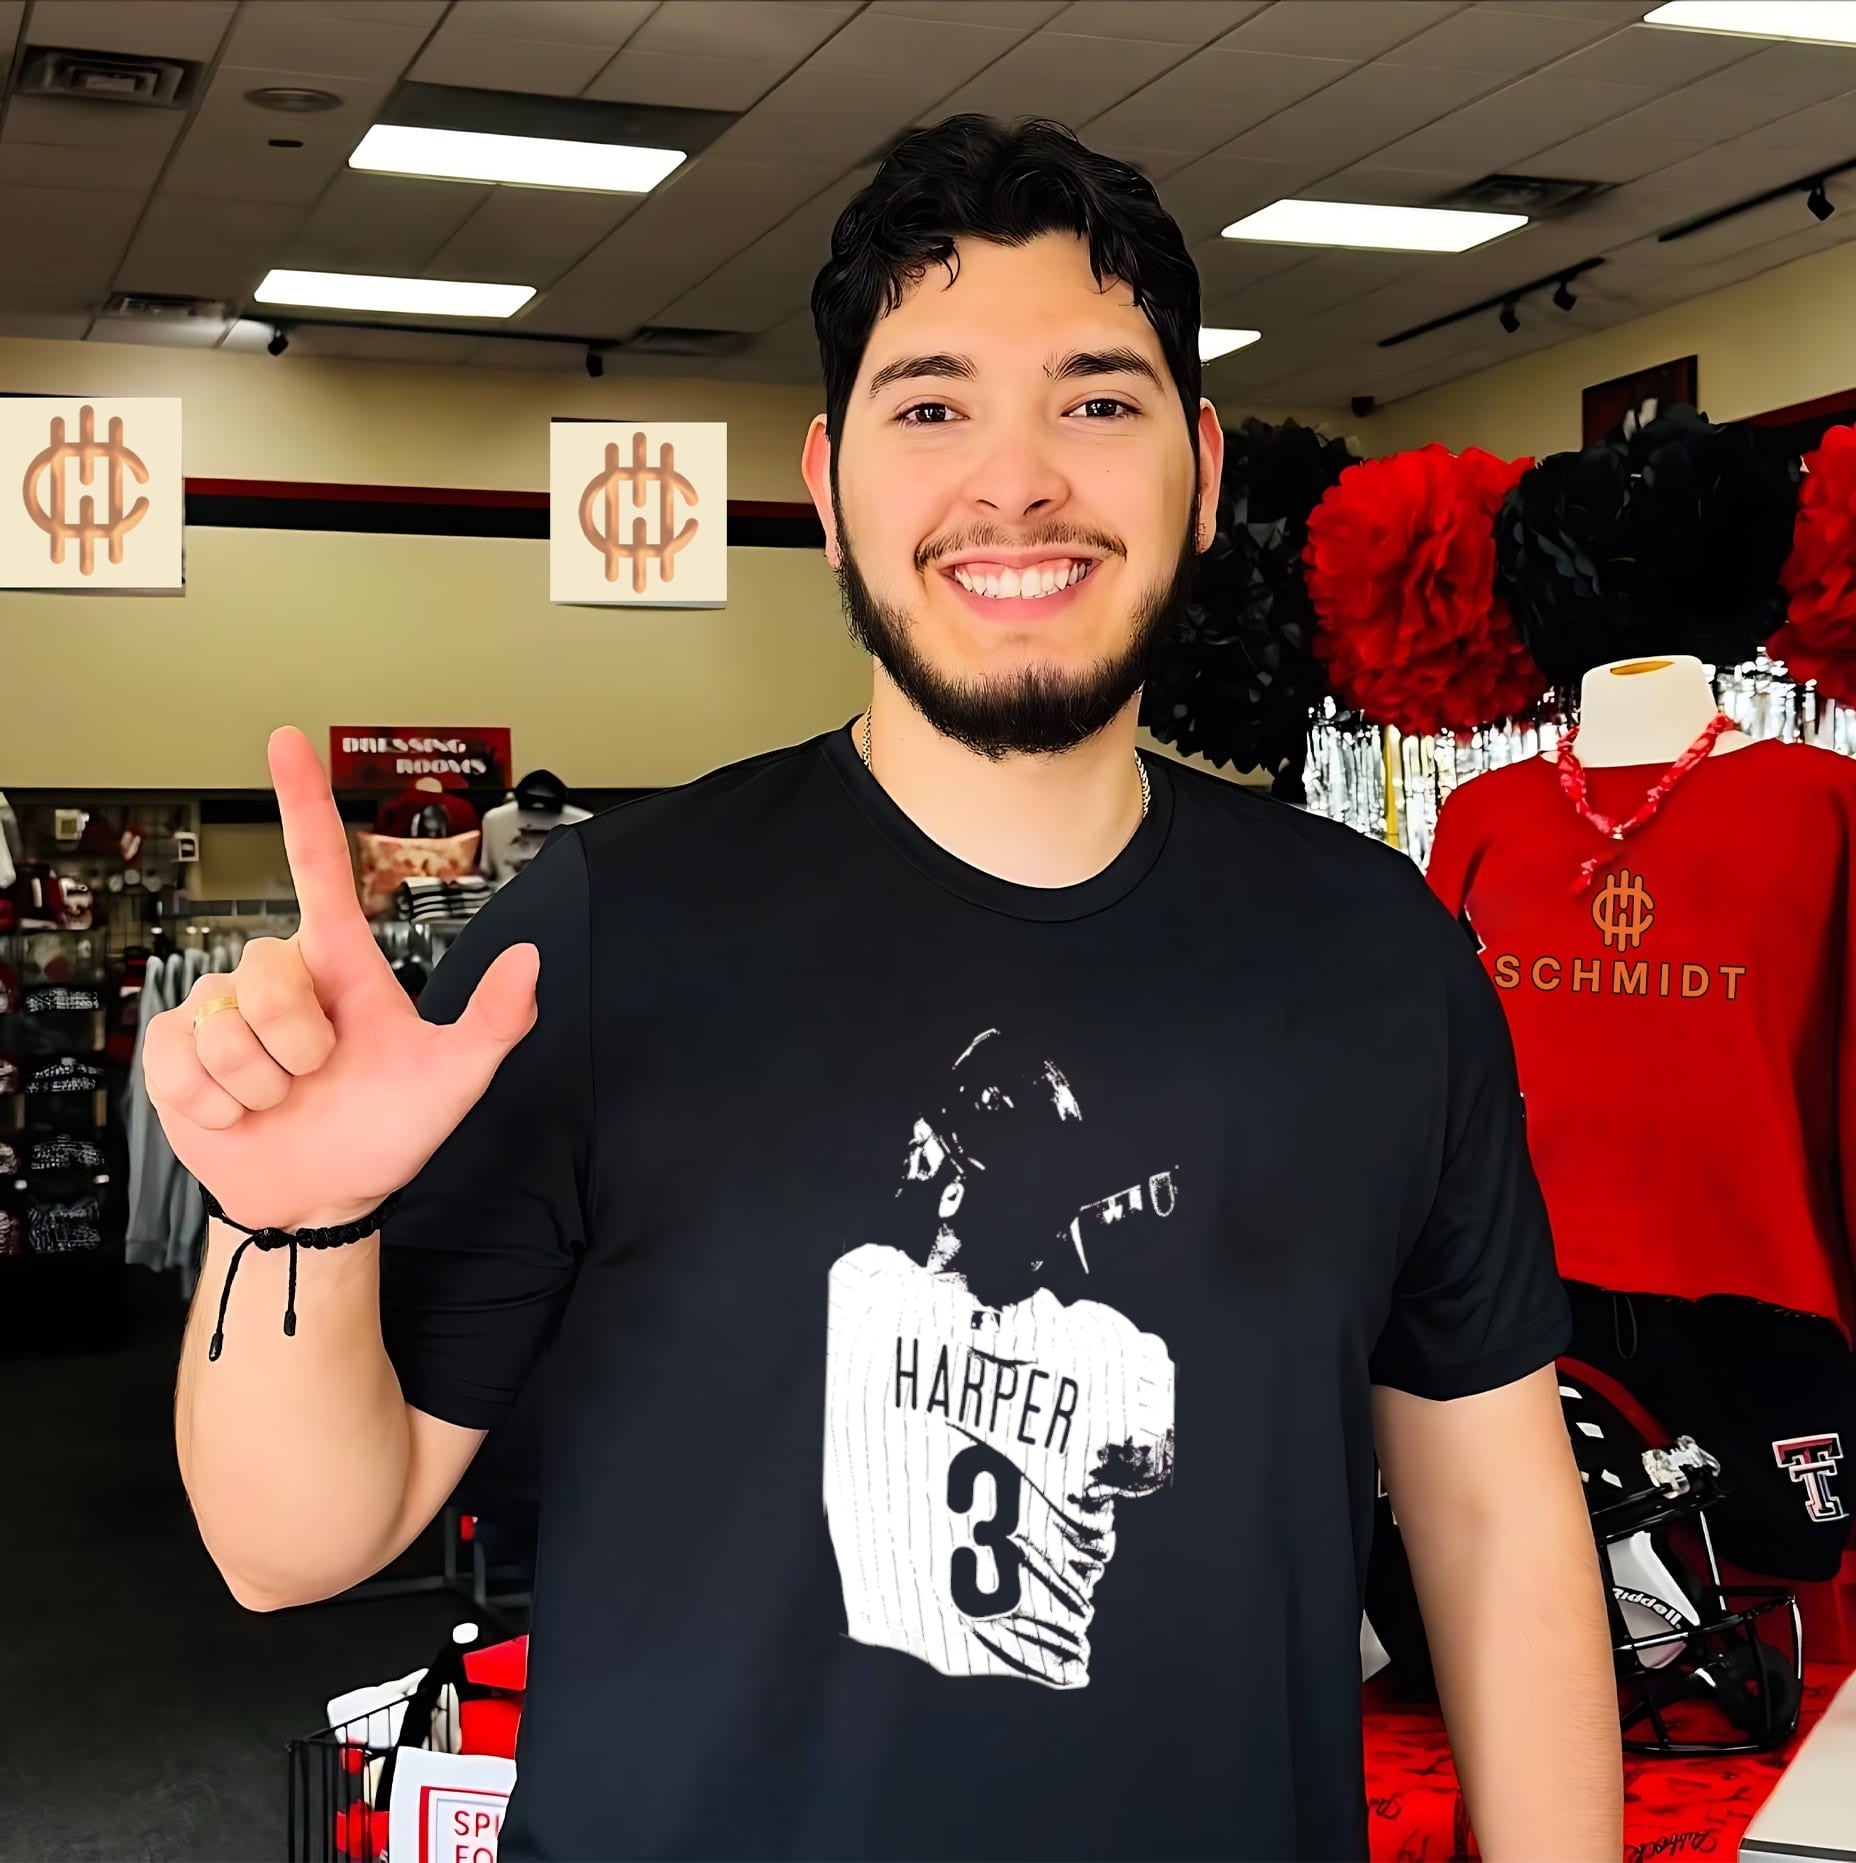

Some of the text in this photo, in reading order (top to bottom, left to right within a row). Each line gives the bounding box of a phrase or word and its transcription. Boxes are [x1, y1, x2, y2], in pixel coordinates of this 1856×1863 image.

[342, 737, 467, 754] DRESSING
[396, 758, 487, 775] ROOMS
[1494, 954, 1747, 1000] SCHMIDT
[896, 1335, 1079, 1455] HARPER
[946, 1446, 1022, 1618] 3
